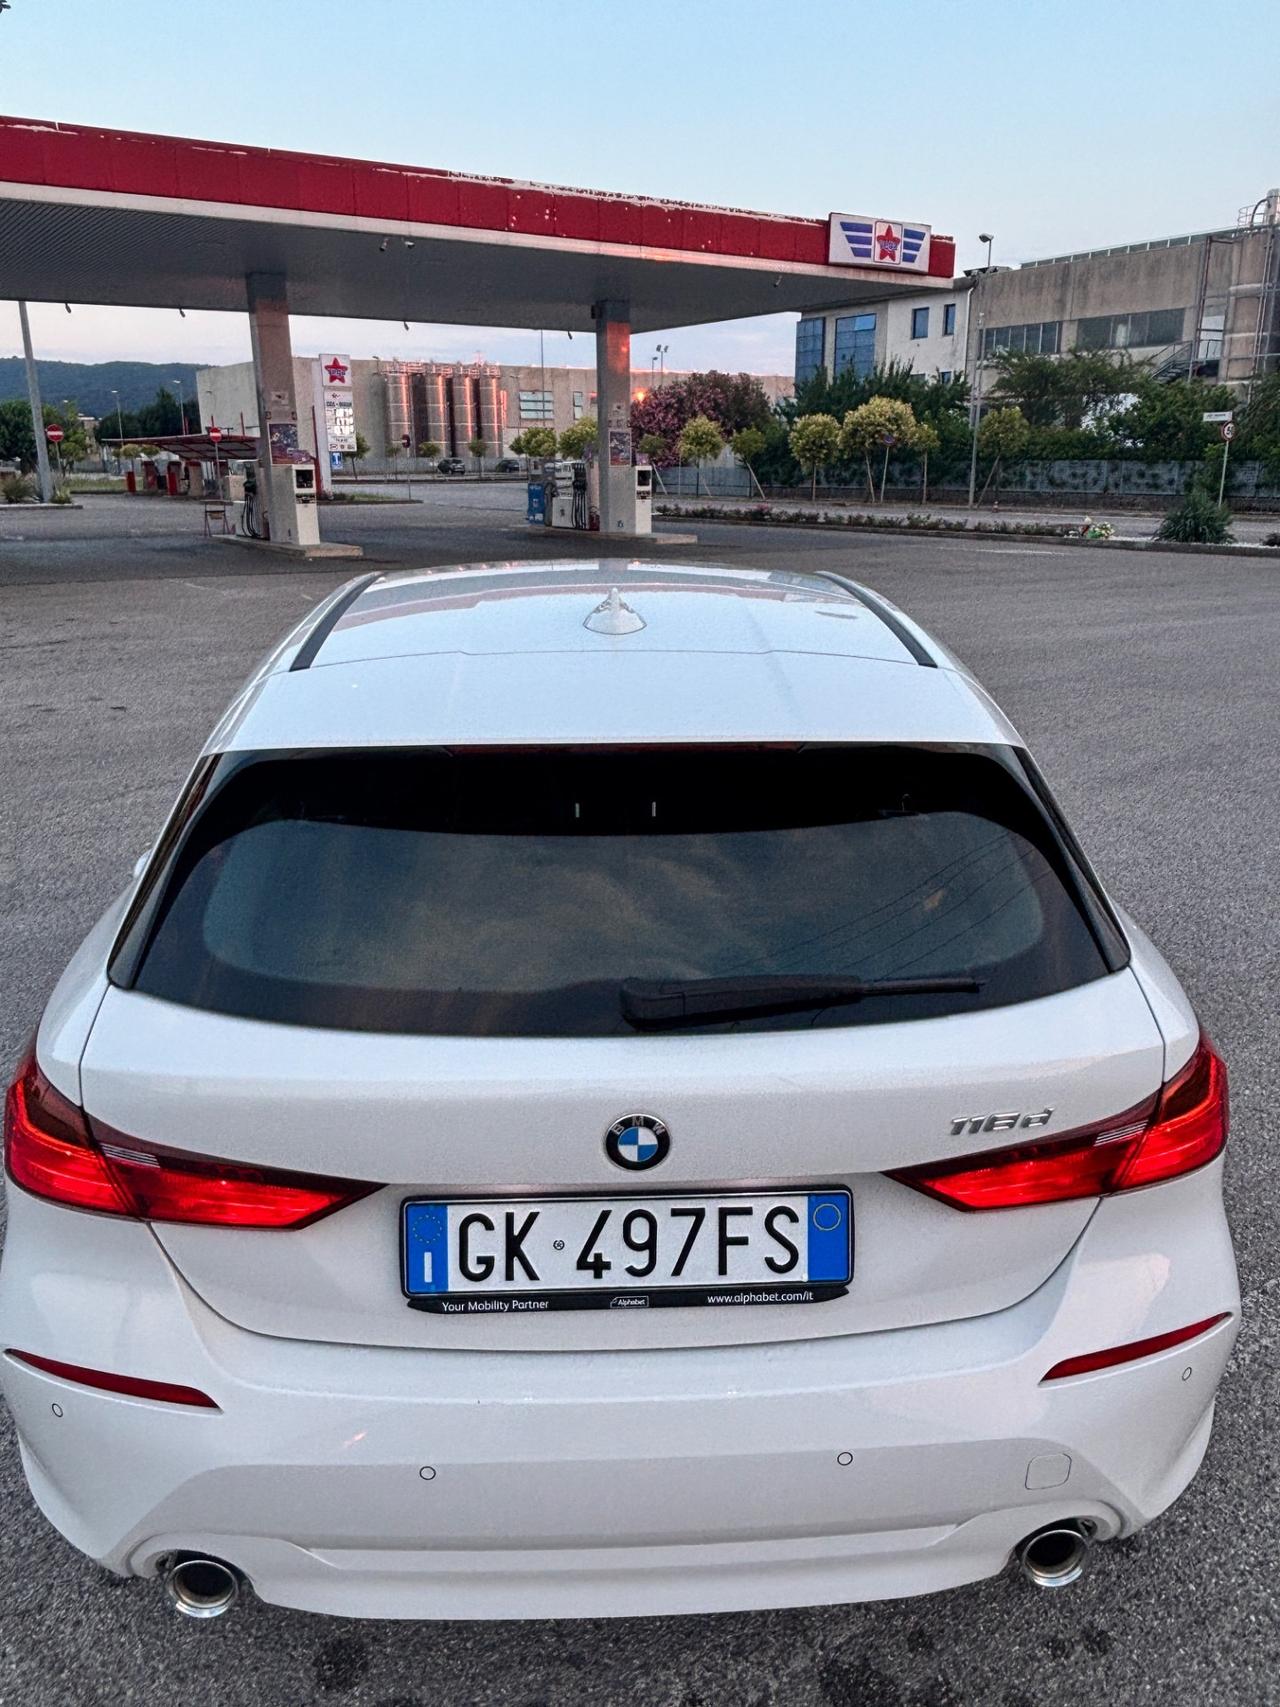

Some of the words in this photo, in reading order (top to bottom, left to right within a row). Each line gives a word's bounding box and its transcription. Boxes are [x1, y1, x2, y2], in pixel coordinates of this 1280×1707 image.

[611, 1116, 666, 1136] BMW
[458, 1211, 541, 1282] GK
[576, 1205, 800, 1280] 497FS
[617, 1298, 646, 1307] Alphabet
[707, 1290, 814, 1304] www.alphabet.com/it
[442, 1302, 465, 1311] Your
[468, 1300, 509, 1312] Mobility
[512, 1300, 549, 1309] Partner
